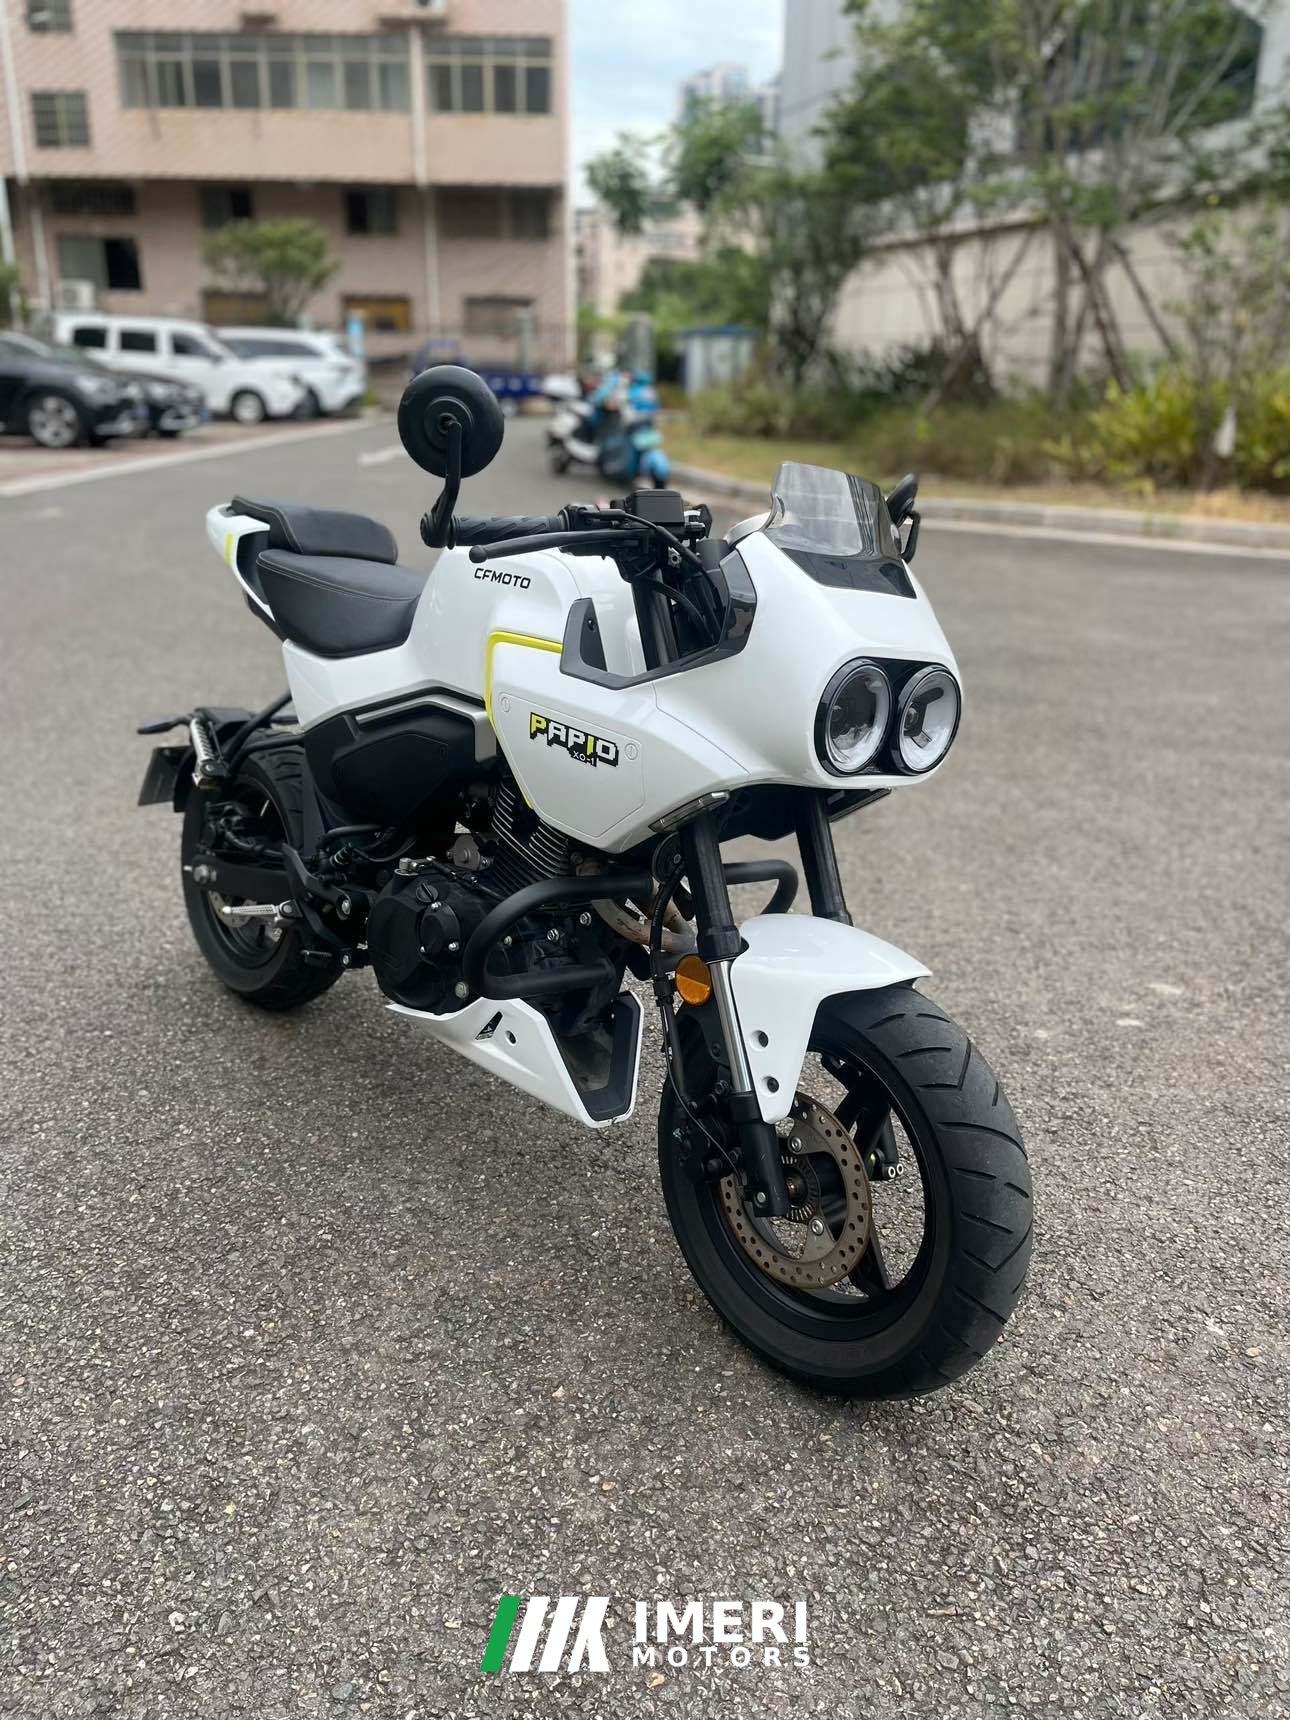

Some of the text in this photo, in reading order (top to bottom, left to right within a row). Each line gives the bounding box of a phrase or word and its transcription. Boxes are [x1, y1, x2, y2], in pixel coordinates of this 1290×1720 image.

[474, 567, 531, 589] CFMOTO
[530, 712, 618, 764] PAPIO
[572, 750, 597, 766] XO-1
